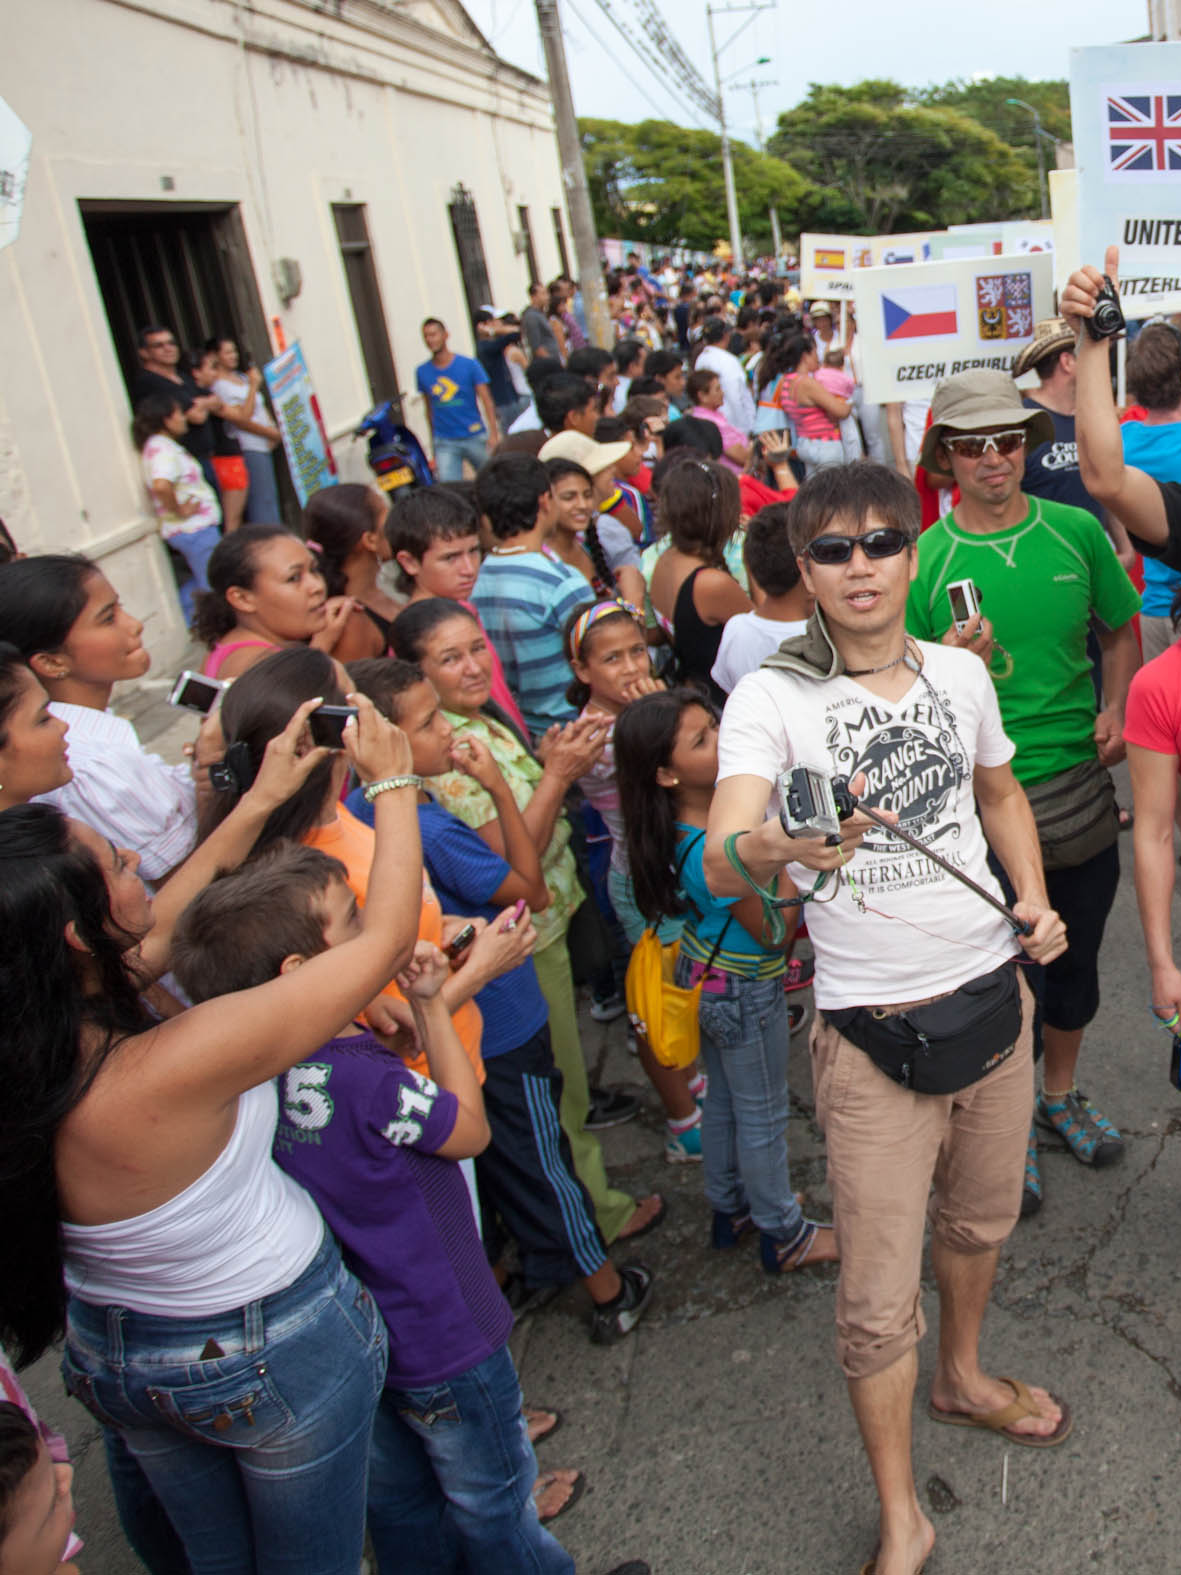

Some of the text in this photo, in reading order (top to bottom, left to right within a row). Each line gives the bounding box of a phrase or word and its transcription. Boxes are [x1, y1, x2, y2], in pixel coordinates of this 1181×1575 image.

[897, 354, 1018, 383] CZECH REPUBLI
[825, 696, 864, 714] AMERIC
[879, 764, 948, 814] COUNTY
[839, 849, 967, 887] INTERNATIOAL
